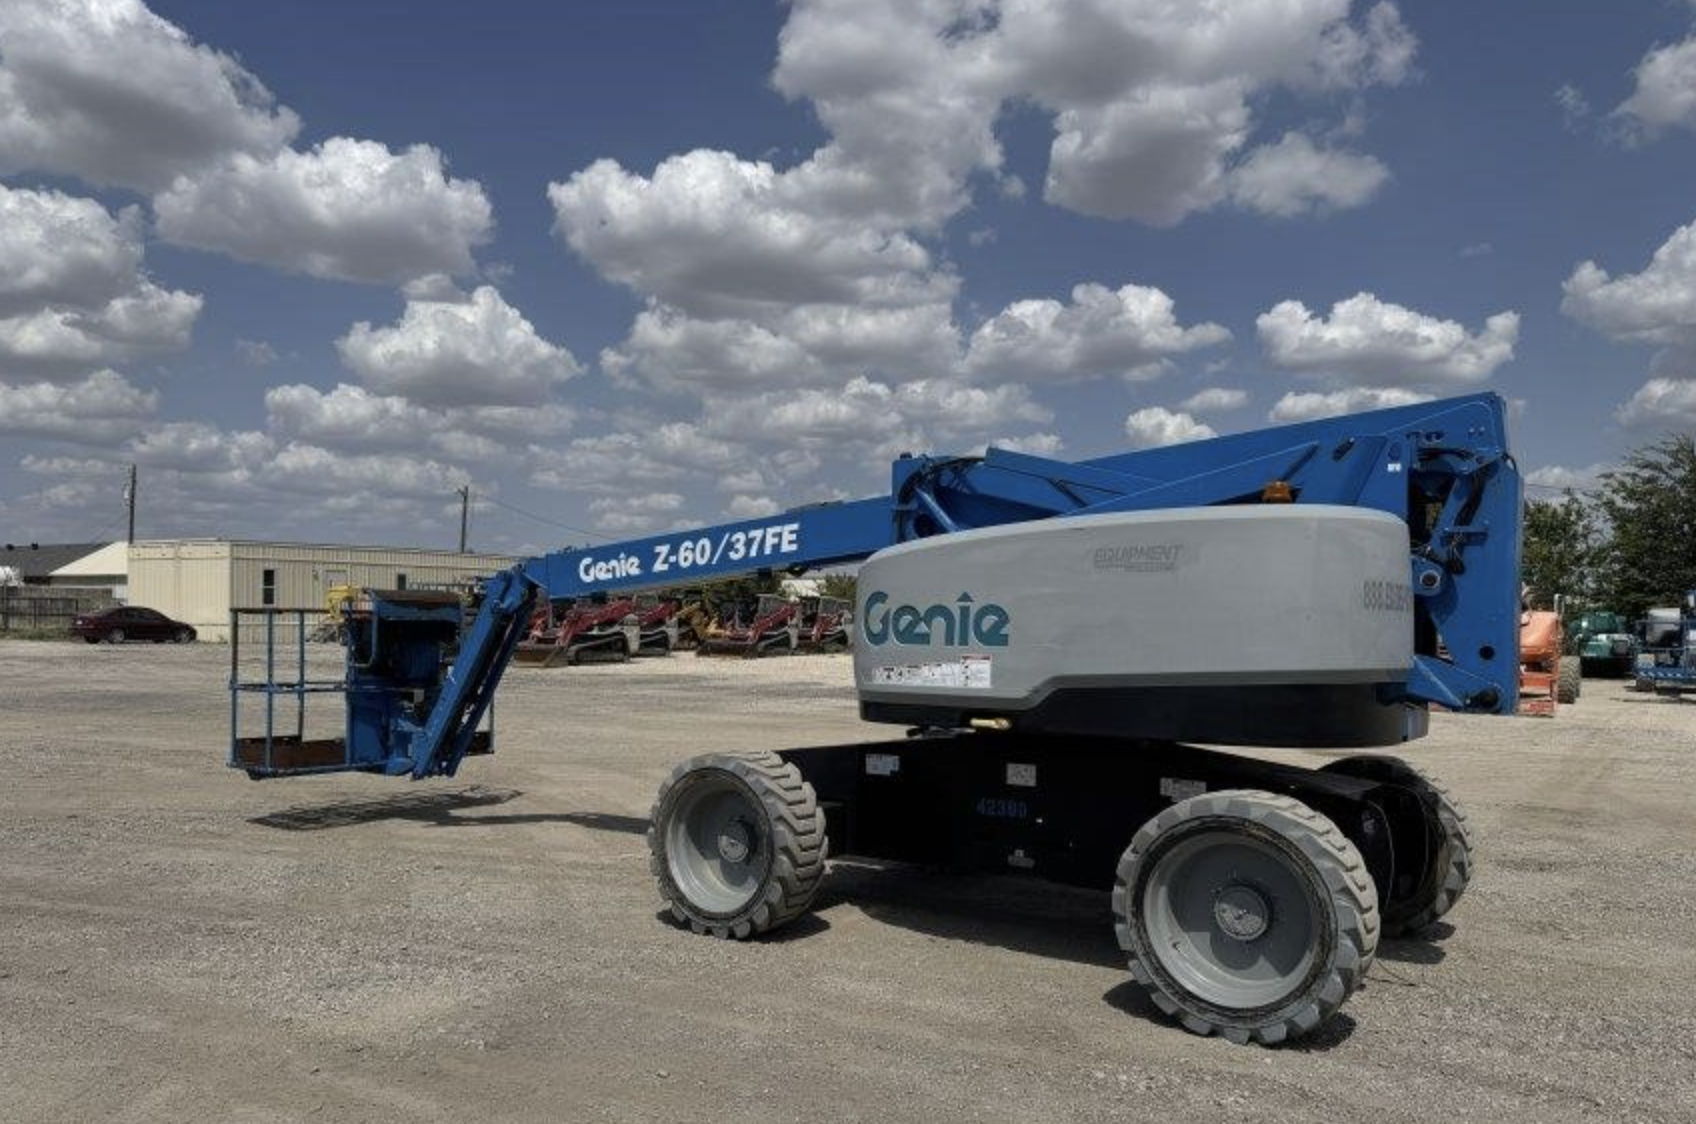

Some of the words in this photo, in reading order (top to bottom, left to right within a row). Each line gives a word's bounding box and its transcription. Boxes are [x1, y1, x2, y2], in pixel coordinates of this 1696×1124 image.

[579, 552, 642, 583] Genie
[652, 523, 799, 573] Z-60/37FE
[864, 591, 1010, 647] Genie
